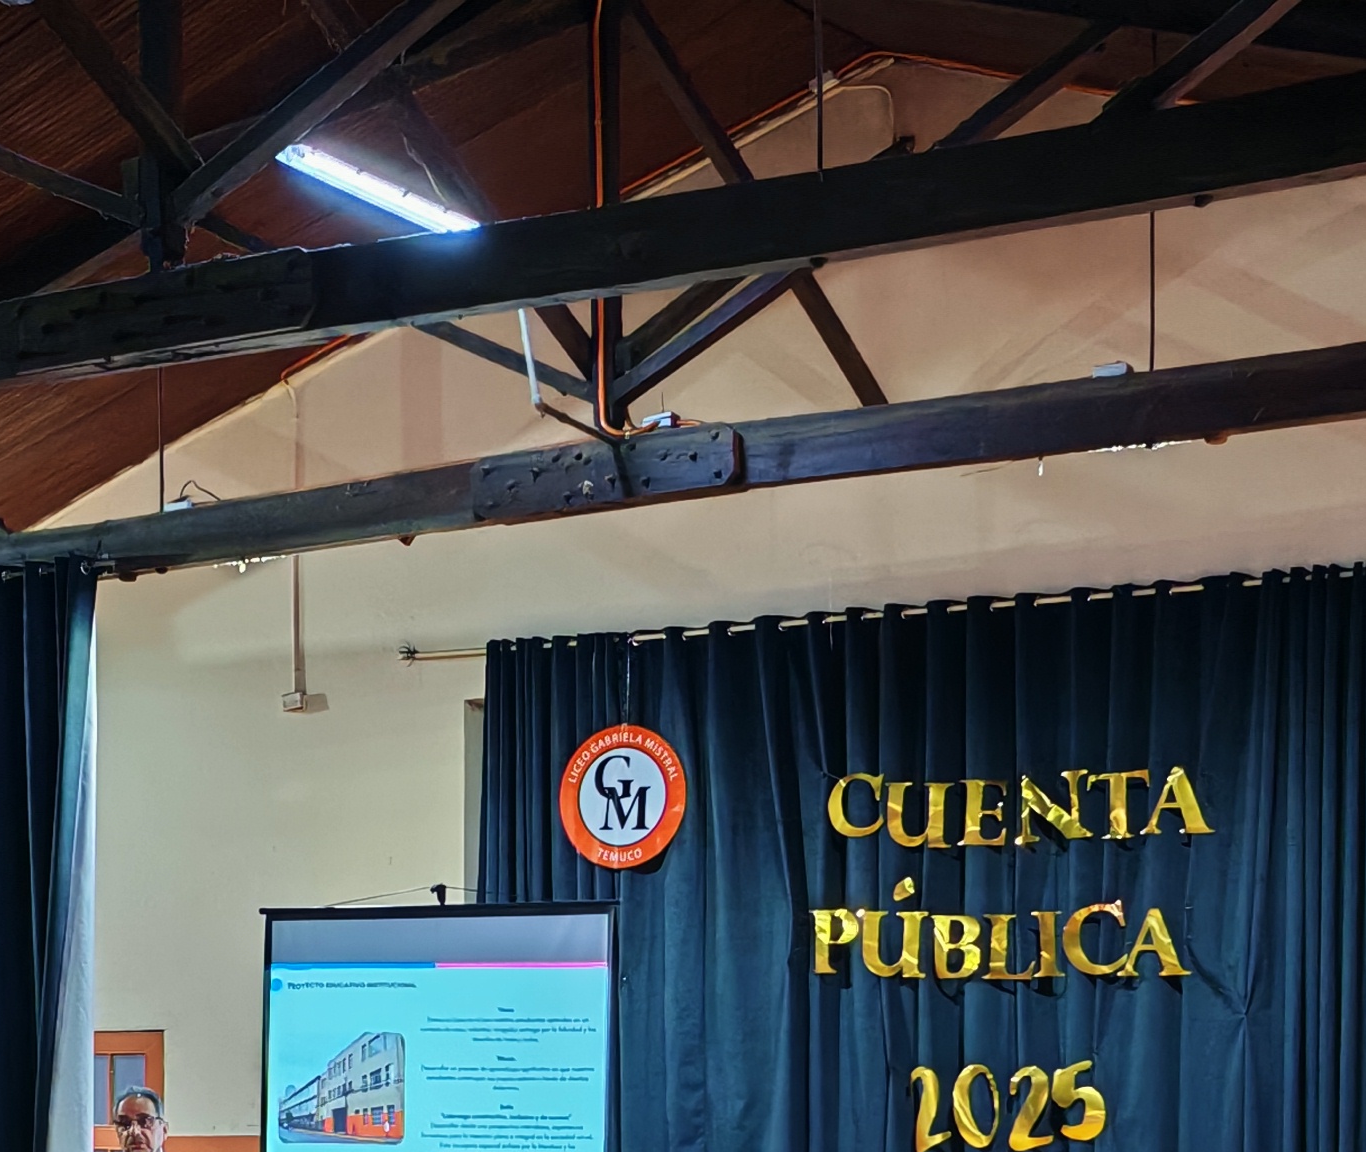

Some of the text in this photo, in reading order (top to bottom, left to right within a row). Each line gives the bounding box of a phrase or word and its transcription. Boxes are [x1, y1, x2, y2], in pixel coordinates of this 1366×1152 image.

[568, 731, 679, 784] LICEO GABRIELA MISTRAL
[827, 766, 1216, 849] CUENTA
[597, 847, 643, 862] TEMUCO
[809, 877, 1193, 980] PÚBLICA
